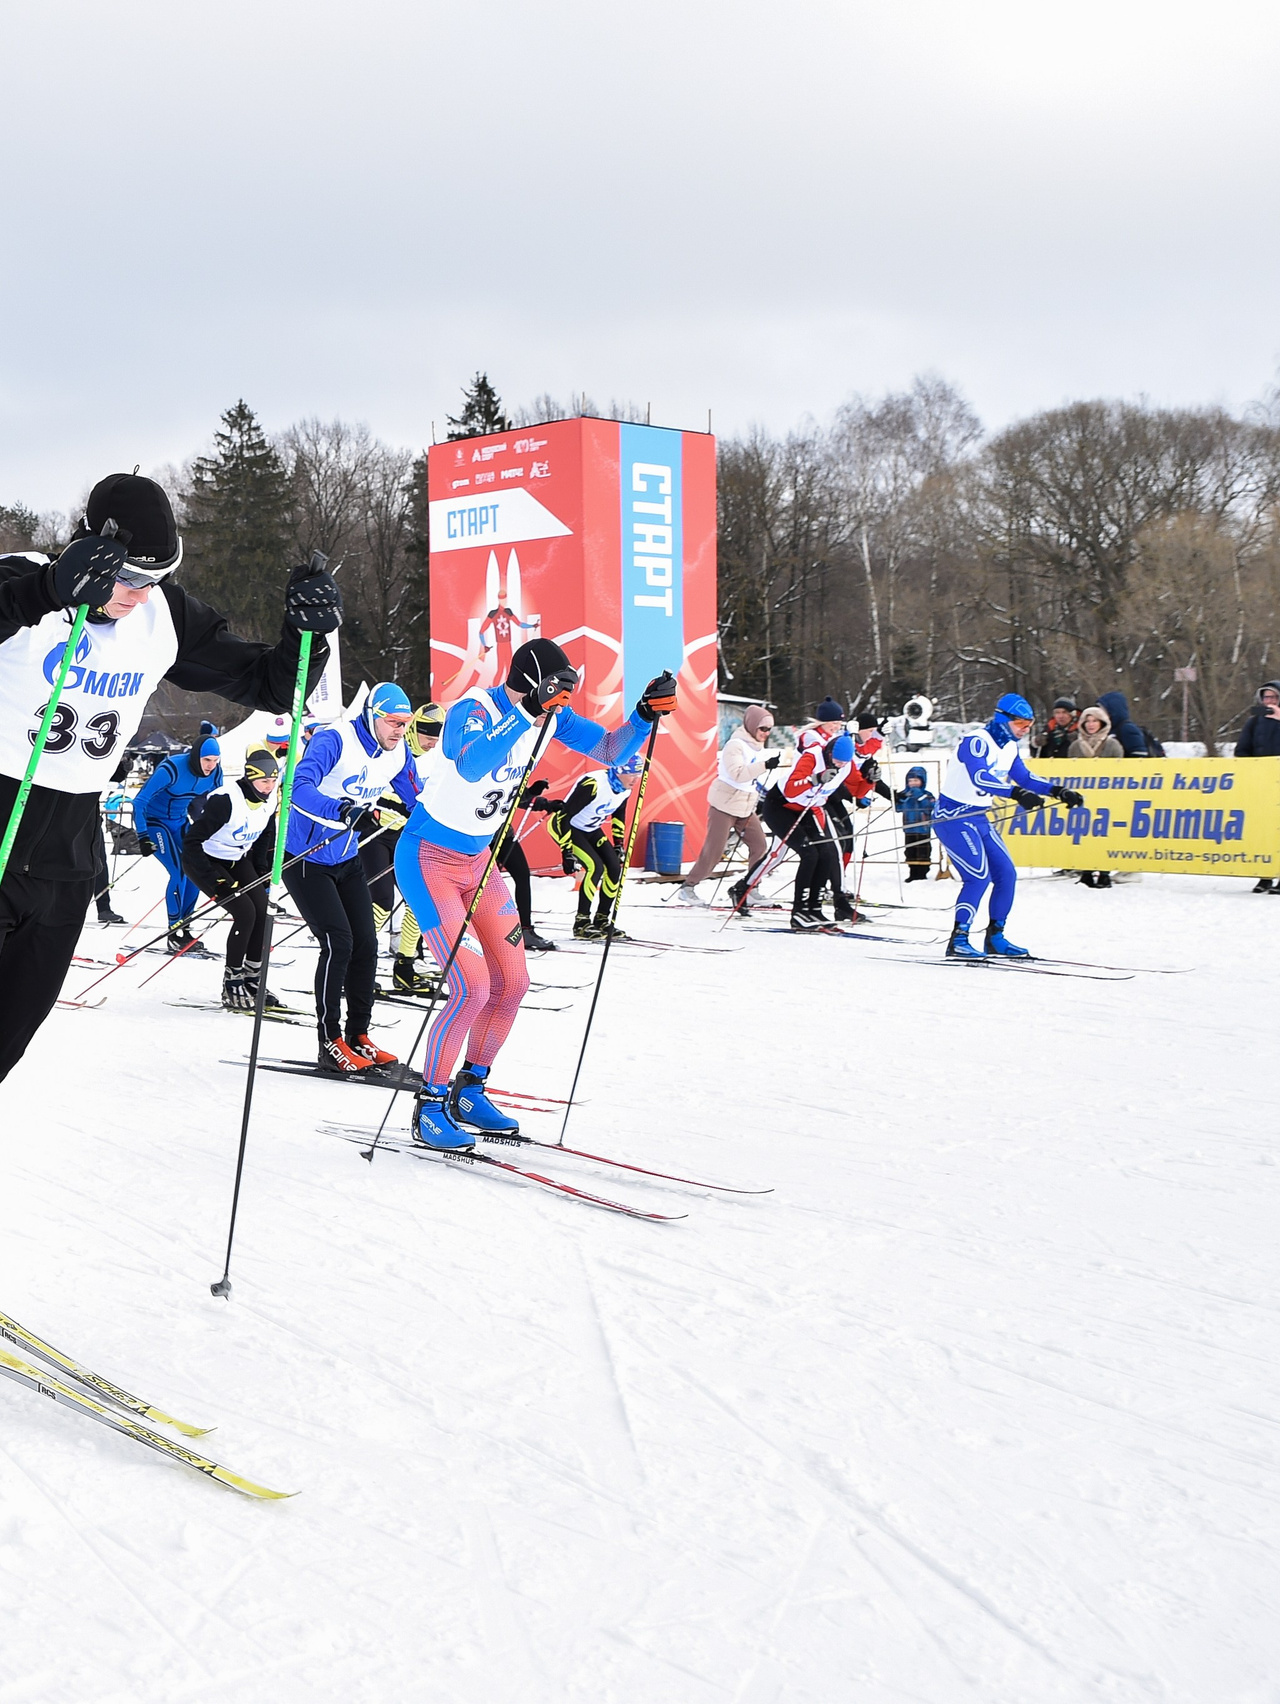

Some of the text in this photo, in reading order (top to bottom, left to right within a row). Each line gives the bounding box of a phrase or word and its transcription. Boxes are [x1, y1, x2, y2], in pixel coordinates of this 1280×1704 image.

[446, 504, 500, 539] СТАРТ
[631, 461, 674, 617] СТАРТ
[28, 701, 122, 760] 33
[486, 713, 517, 742] Webasto
[1172, 773, 1235, 794] клуб
[1008, 800, 1246, 845] Альфа-Битца
[1106, 849, 1273, 864] www.bitza-sport.ru
[323, 1040, 359, 1072] alpina
[419, 1114, 444, 1136] SPINE
[482, 1136, 522, 1148] MADSHUS
[442, 1152, 476, 1166] MADSHUS
[4, 1331, 18, 1345] RCS
[40, 1385, 57, 1400] RCS
[124, 1424, 202, 1462] FISCHER
